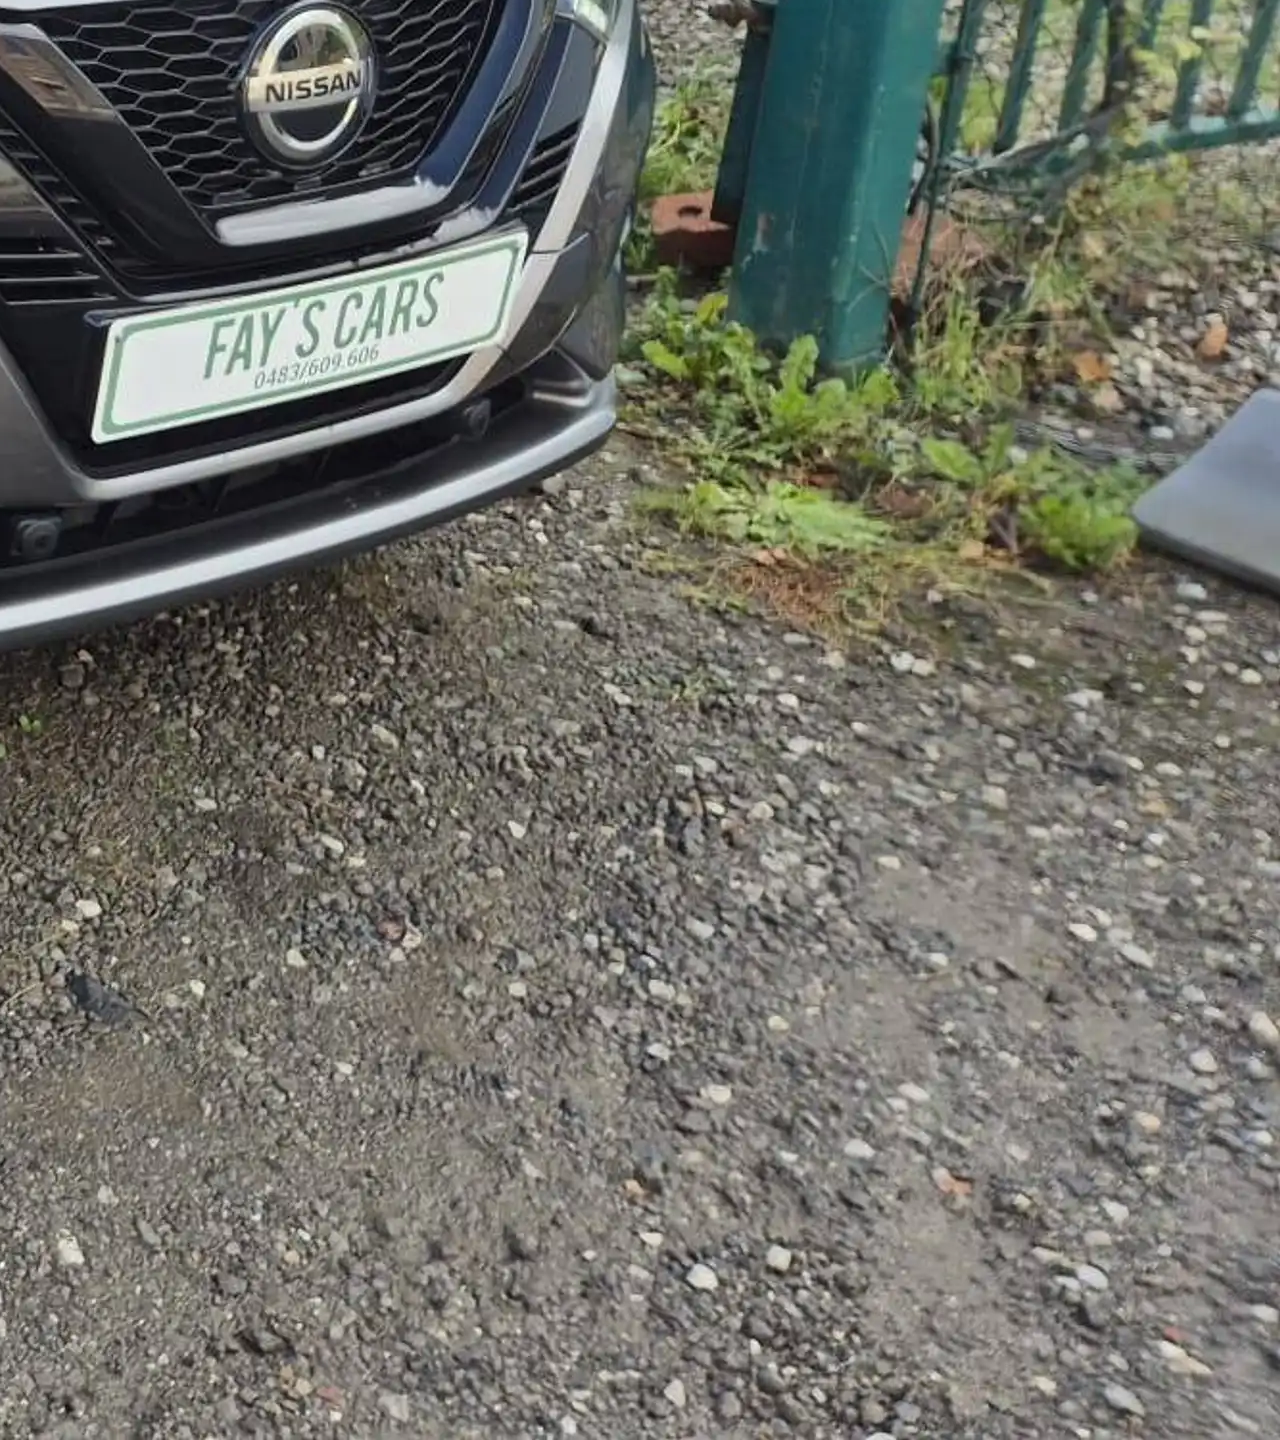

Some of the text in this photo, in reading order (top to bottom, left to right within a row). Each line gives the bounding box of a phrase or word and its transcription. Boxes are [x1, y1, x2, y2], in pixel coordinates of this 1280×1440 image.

[265, 71, 362, 103] NISSAN
[333, 271, 444, 349] CARS
[253, 344, 380, 390] 0483/609.606
